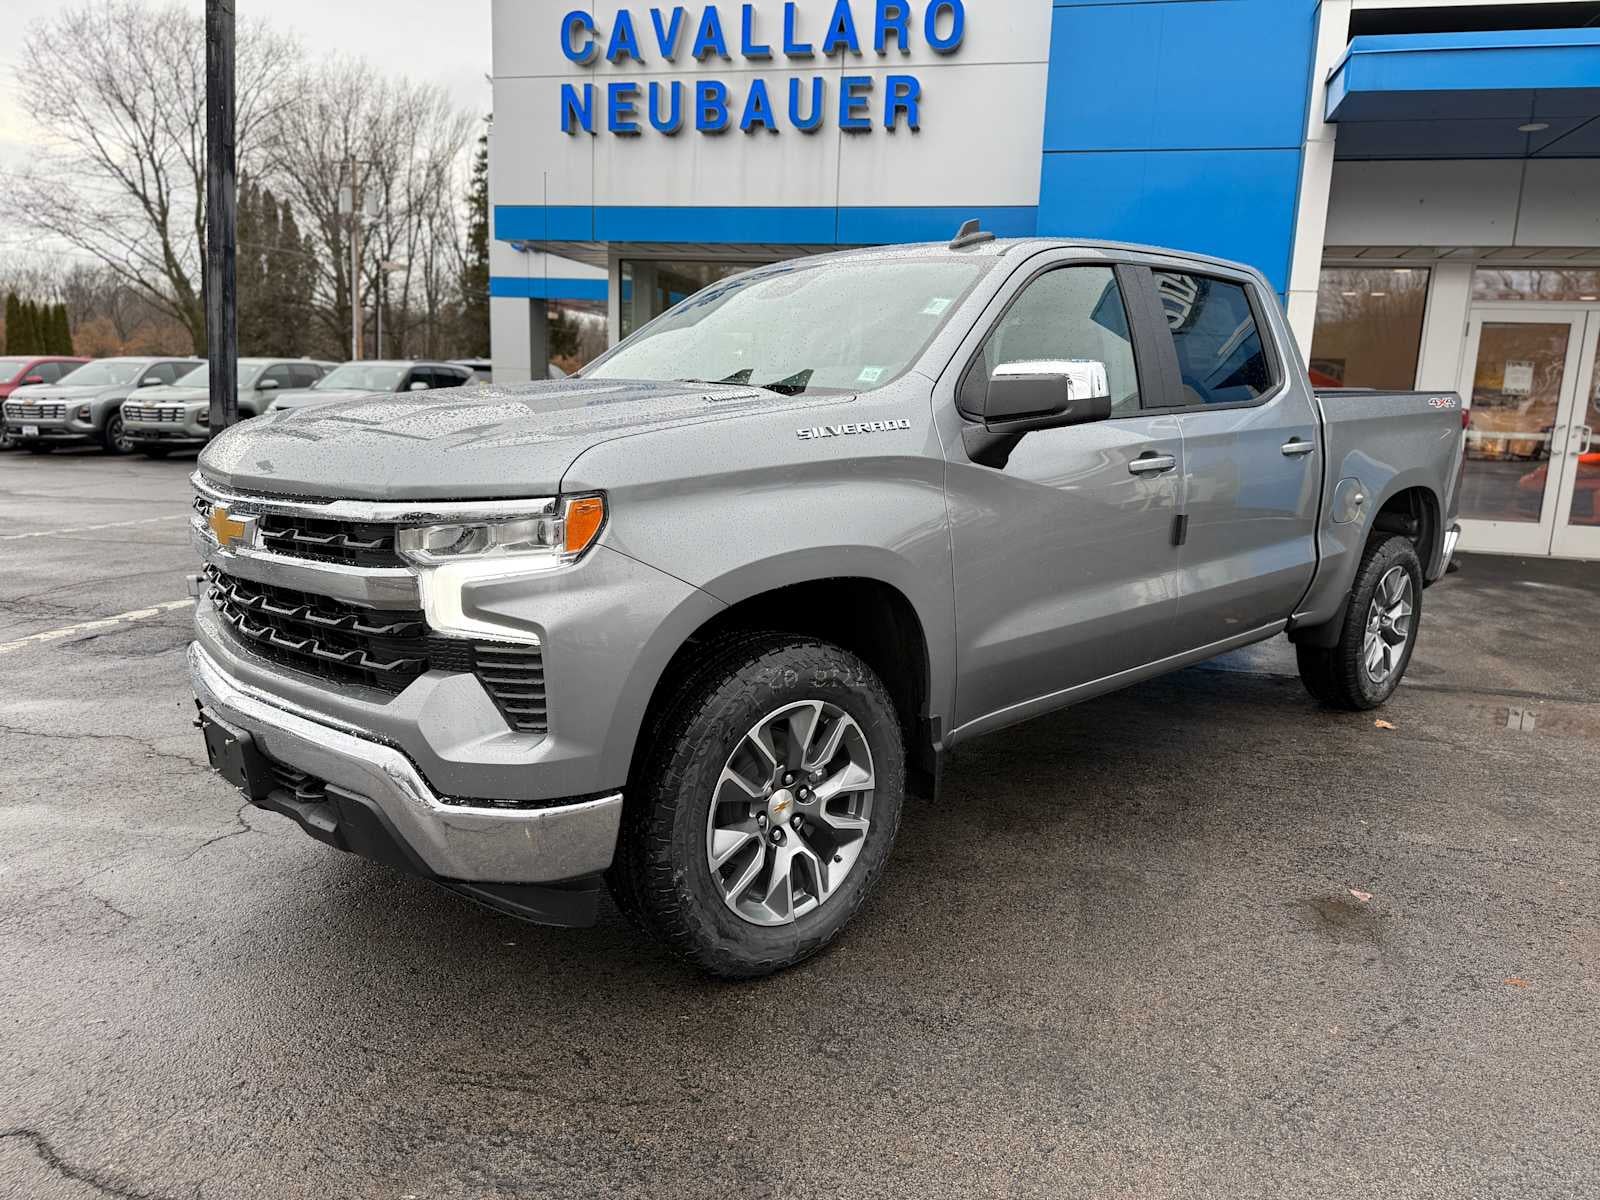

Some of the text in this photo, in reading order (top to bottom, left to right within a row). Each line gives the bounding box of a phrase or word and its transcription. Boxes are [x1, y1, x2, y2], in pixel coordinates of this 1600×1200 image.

[560, 0, 967, 64] CAVALLARO
[560, 75, 922, 135] NEUBAUER
[797, 418, 911, 440] SILVERADO
